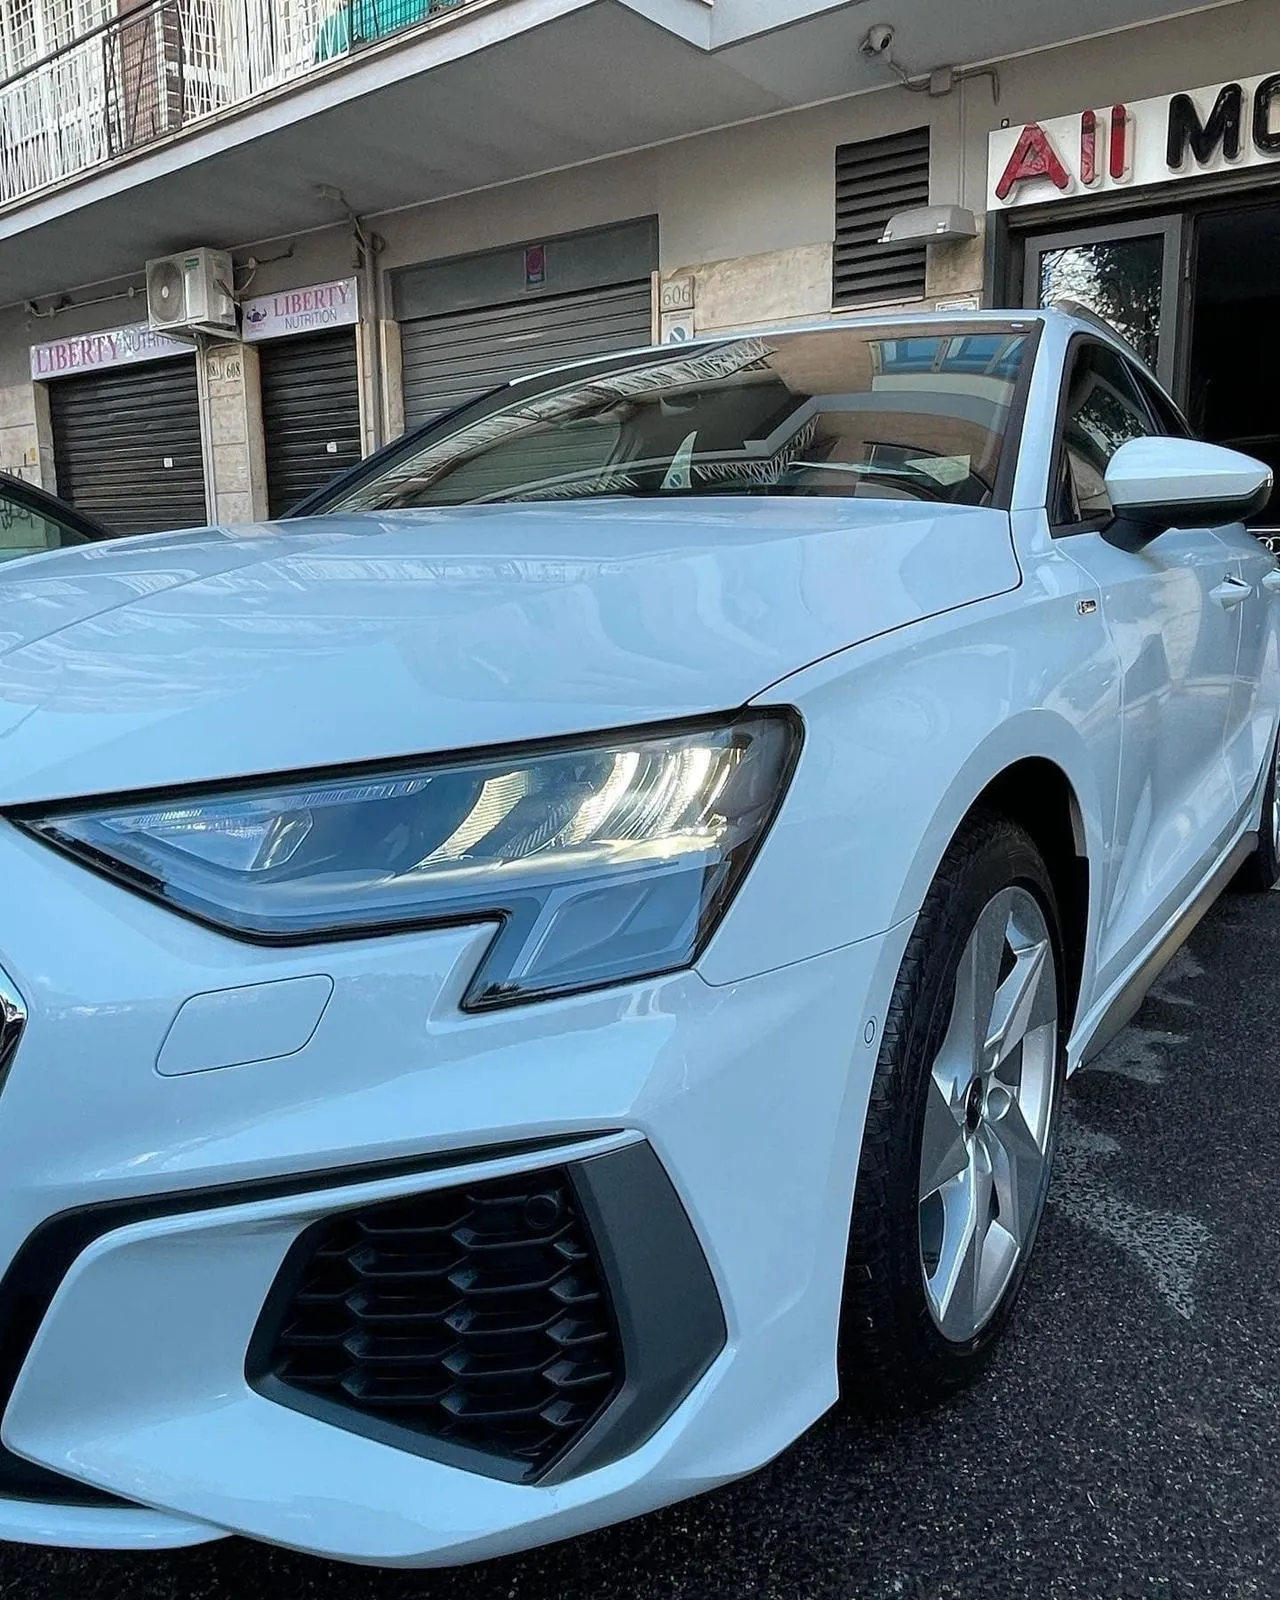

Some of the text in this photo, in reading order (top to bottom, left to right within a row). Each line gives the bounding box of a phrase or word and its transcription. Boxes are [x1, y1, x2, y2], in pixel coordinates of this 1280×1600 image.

[995, 103, 1127, 201] All
[273, 284, 349, 317] LIBERTY
[663, 284, 691, 306] 606
[285, 307, 338, 329] NUTRITION
[36, 332, 121, 374] LIBERTY
